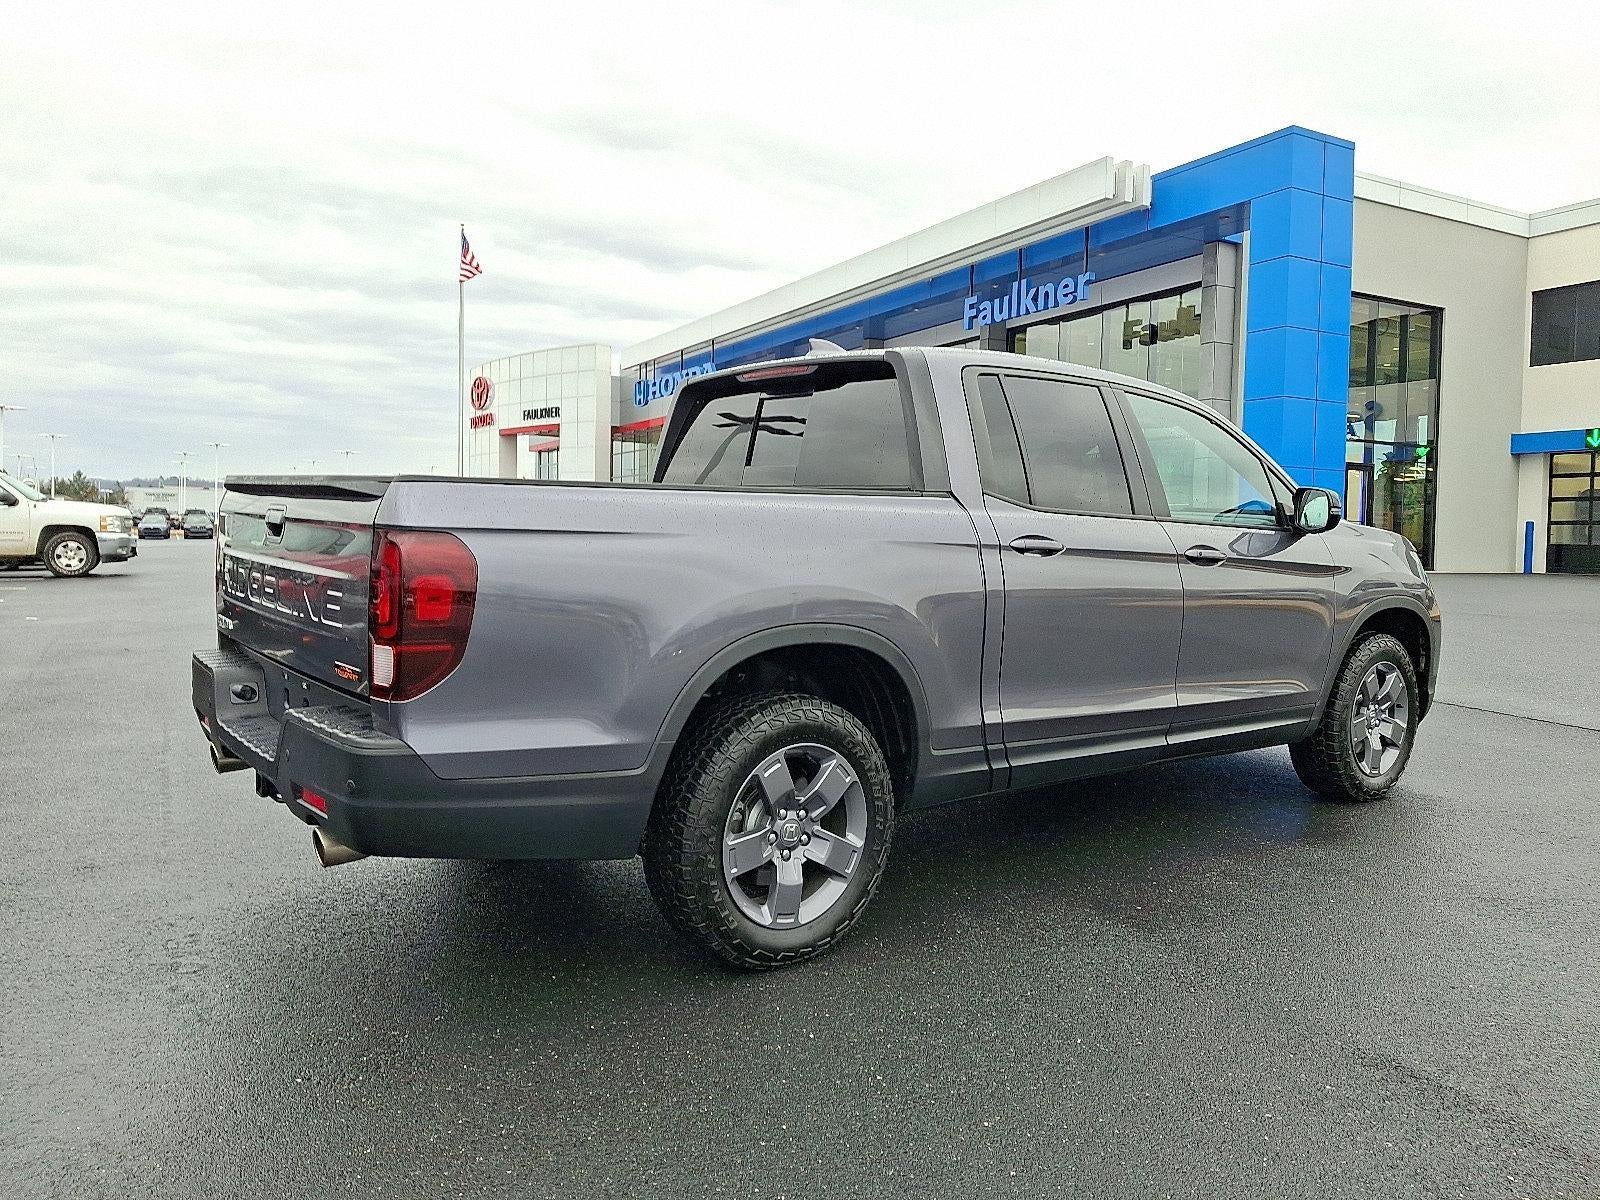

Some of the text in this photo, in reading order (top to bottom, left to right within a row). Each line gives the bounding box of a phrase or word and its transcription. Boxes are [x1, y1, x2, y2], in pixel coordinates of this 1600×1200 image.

[963, 271, 1096, 331] Faulkner
[648, 362, 717, 400] HONDA
[470, 413, 495, 429] TOYOTA
[522, 406, 561, 422] FAULKNER
